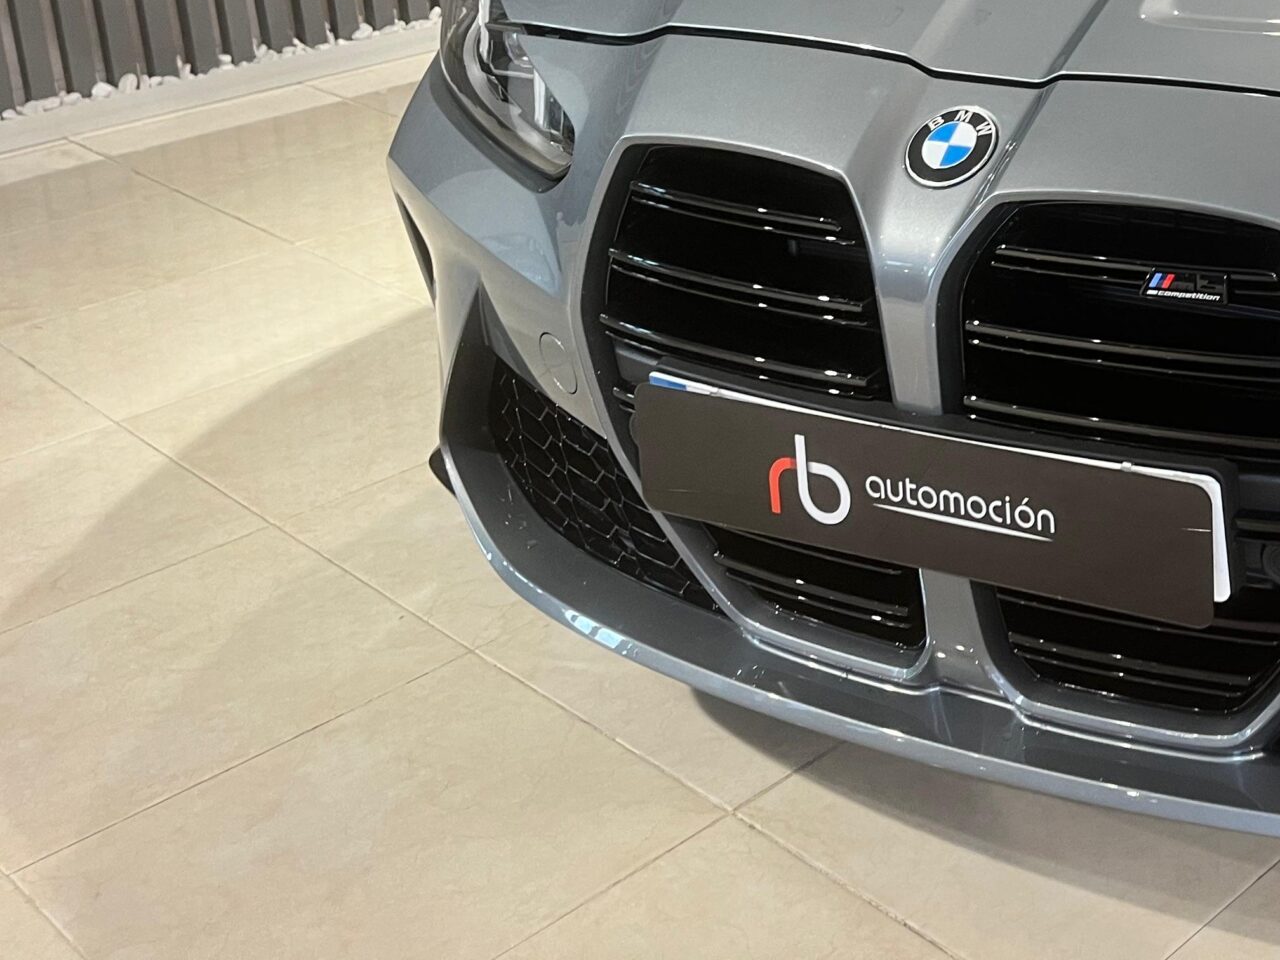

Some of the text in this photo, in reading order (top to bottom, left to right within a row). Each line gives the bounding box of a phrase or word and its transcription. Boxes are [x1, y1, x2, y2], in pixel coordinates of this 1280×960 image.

[927, 109, 993, 137] BMW
[768, 433, 1056, 534] rb automoción
